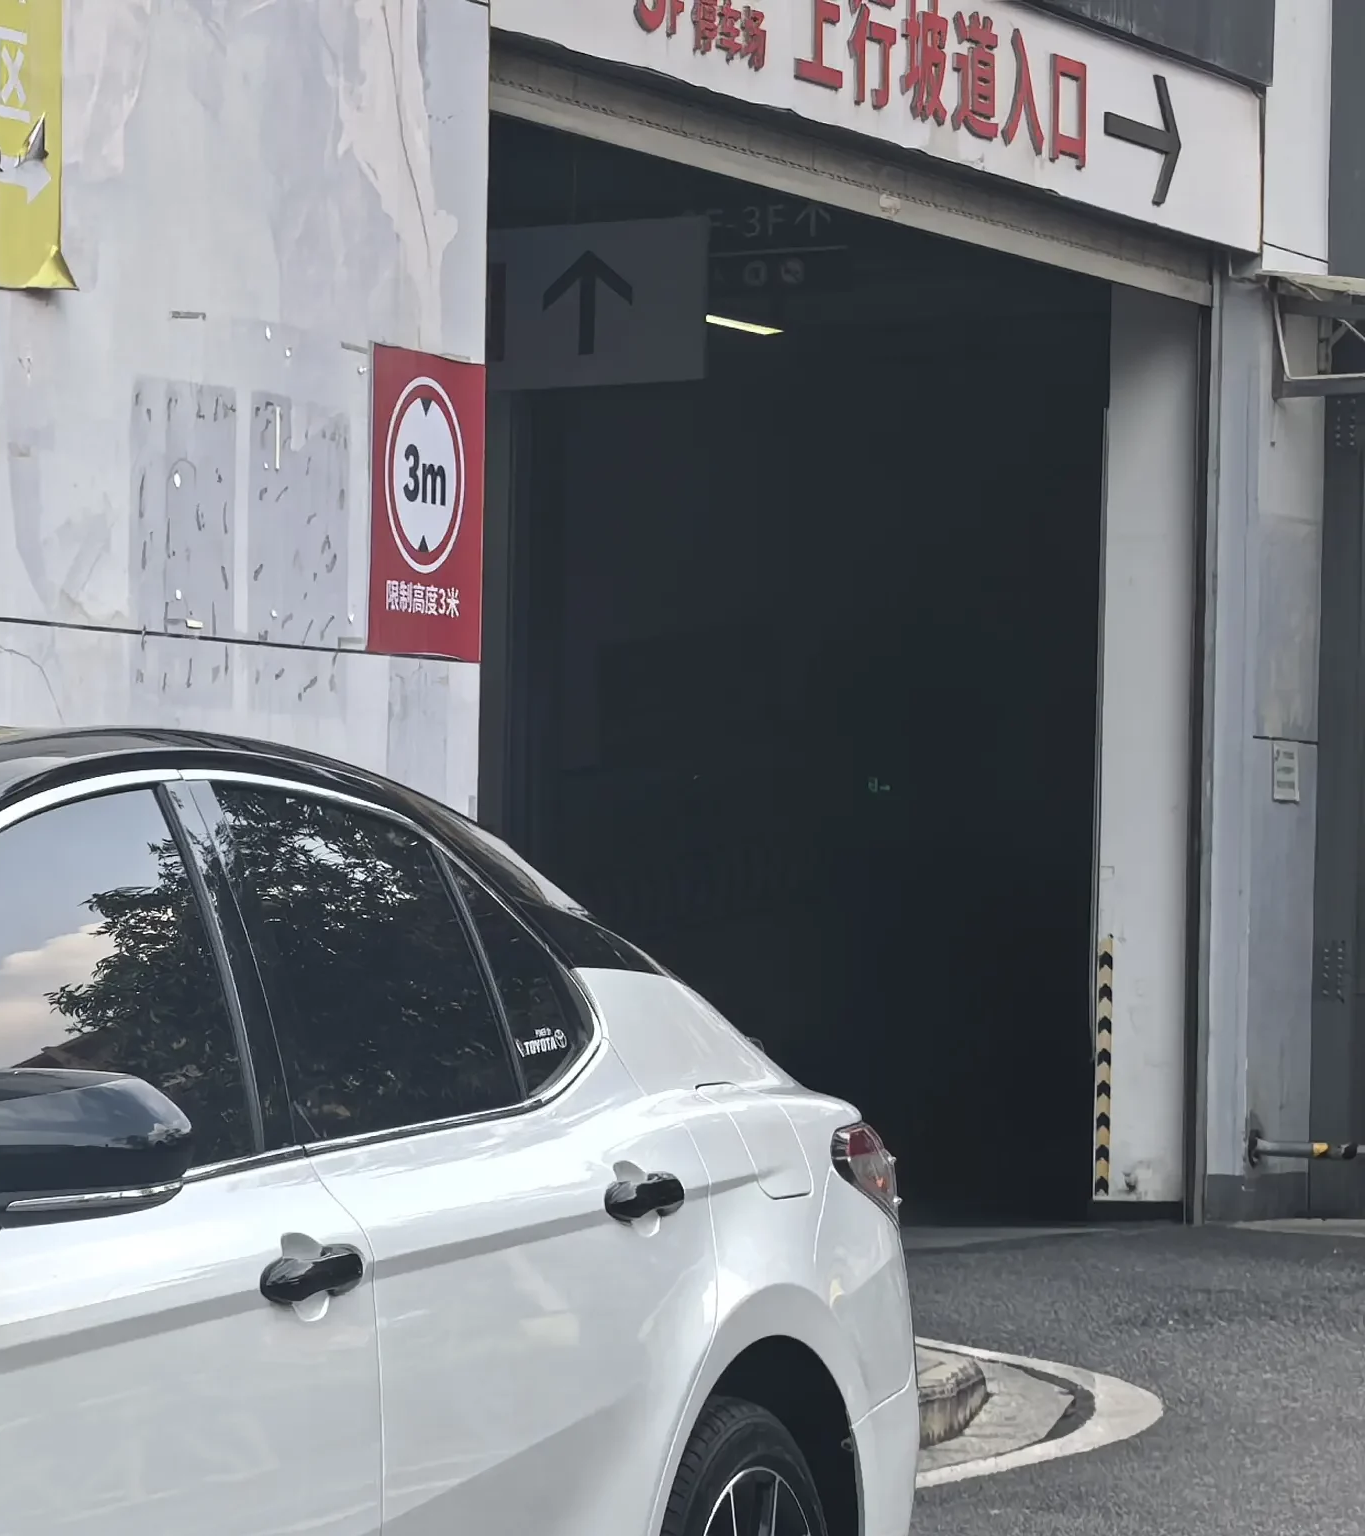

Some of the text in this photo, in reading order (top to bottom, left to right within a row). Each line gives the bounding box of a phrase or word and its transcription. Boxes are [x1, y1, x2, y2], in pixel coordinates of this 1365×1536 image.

[793, 0, 1087, 169] 上行坡道入口
[402, 443, 447, 507] 3m
[385, 579, 460, 618] 限制高度3米
[523, 1036, 558, 1056] TOYOTA
